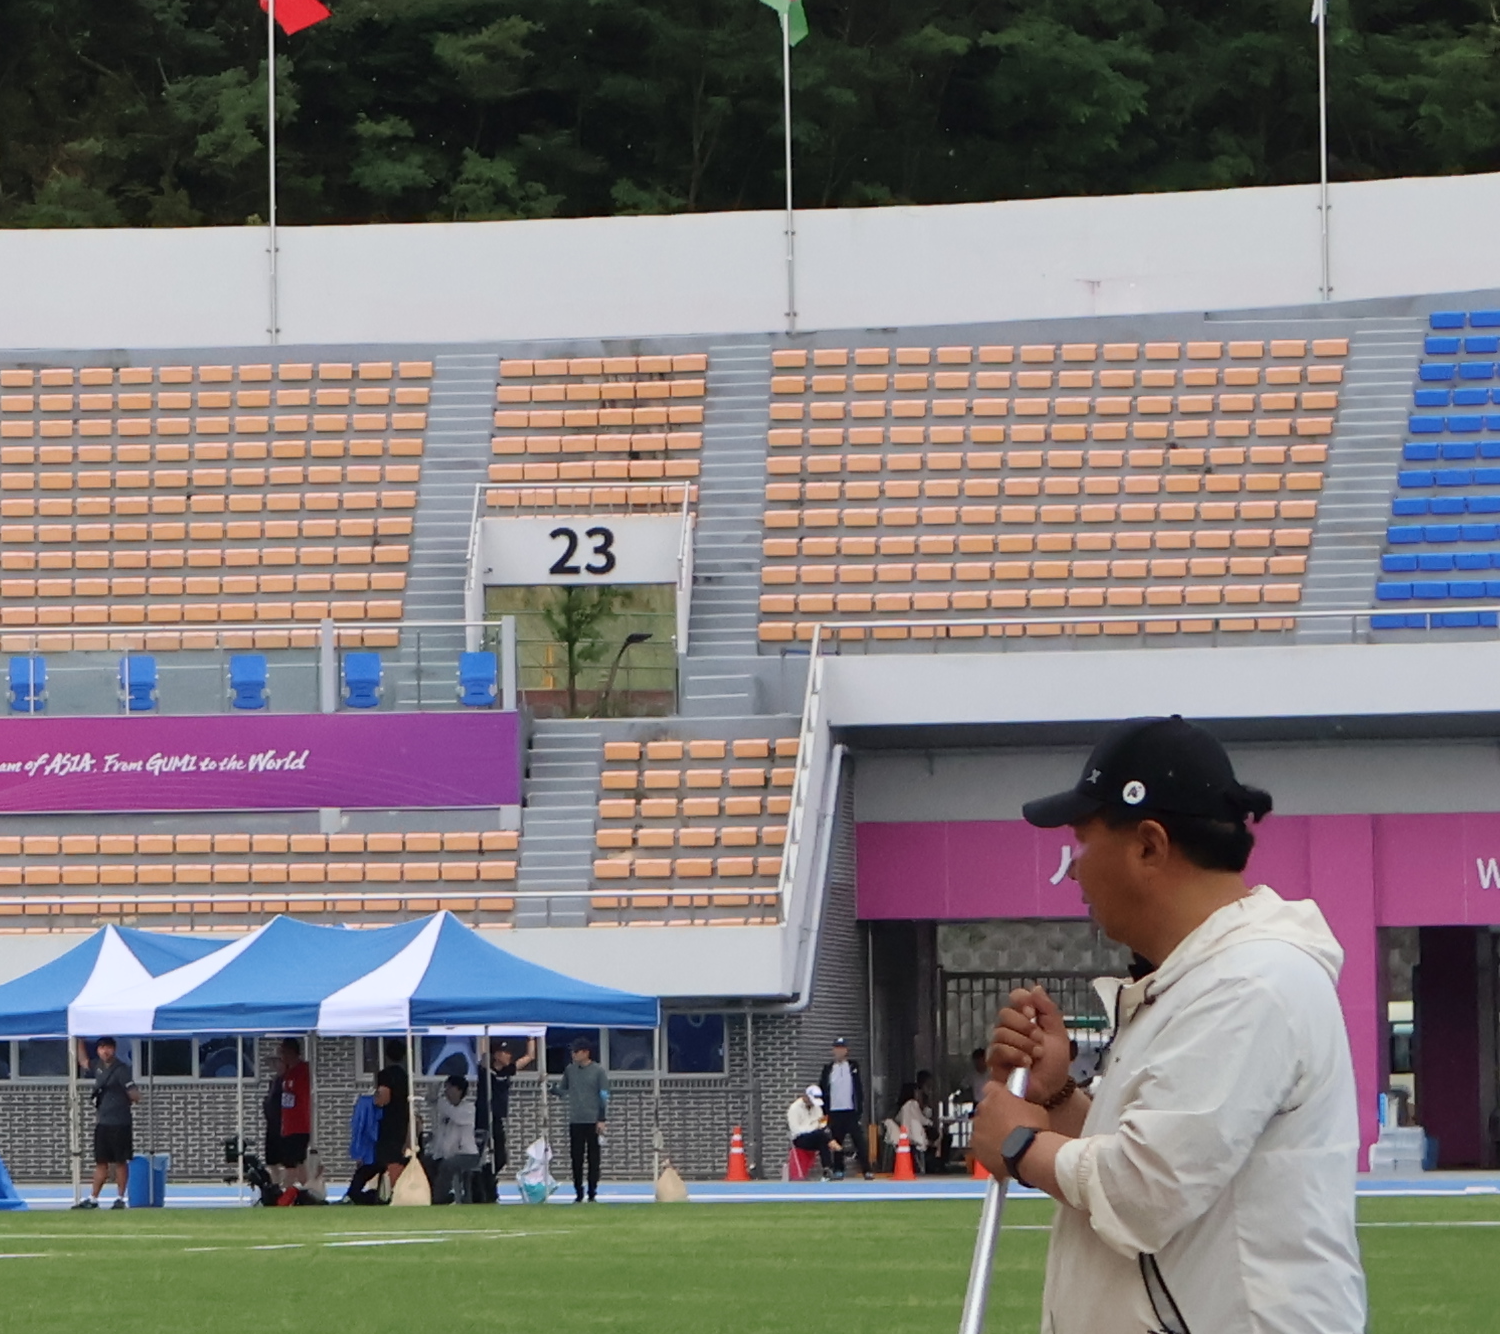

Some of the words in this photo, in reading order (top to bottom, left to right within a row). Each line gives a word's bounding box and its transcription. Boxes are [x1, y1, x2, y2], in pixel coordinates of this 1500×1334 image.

[549, 527, 616, 575] 23
[23, 753, 50, 777] of
[102, 753, 143, 773] From
[145, 752, 198, 776] GUMI
[199, 757, 217, 773] to
[217, 754, 247, 771] the
[248, 749, 310, 772] World
